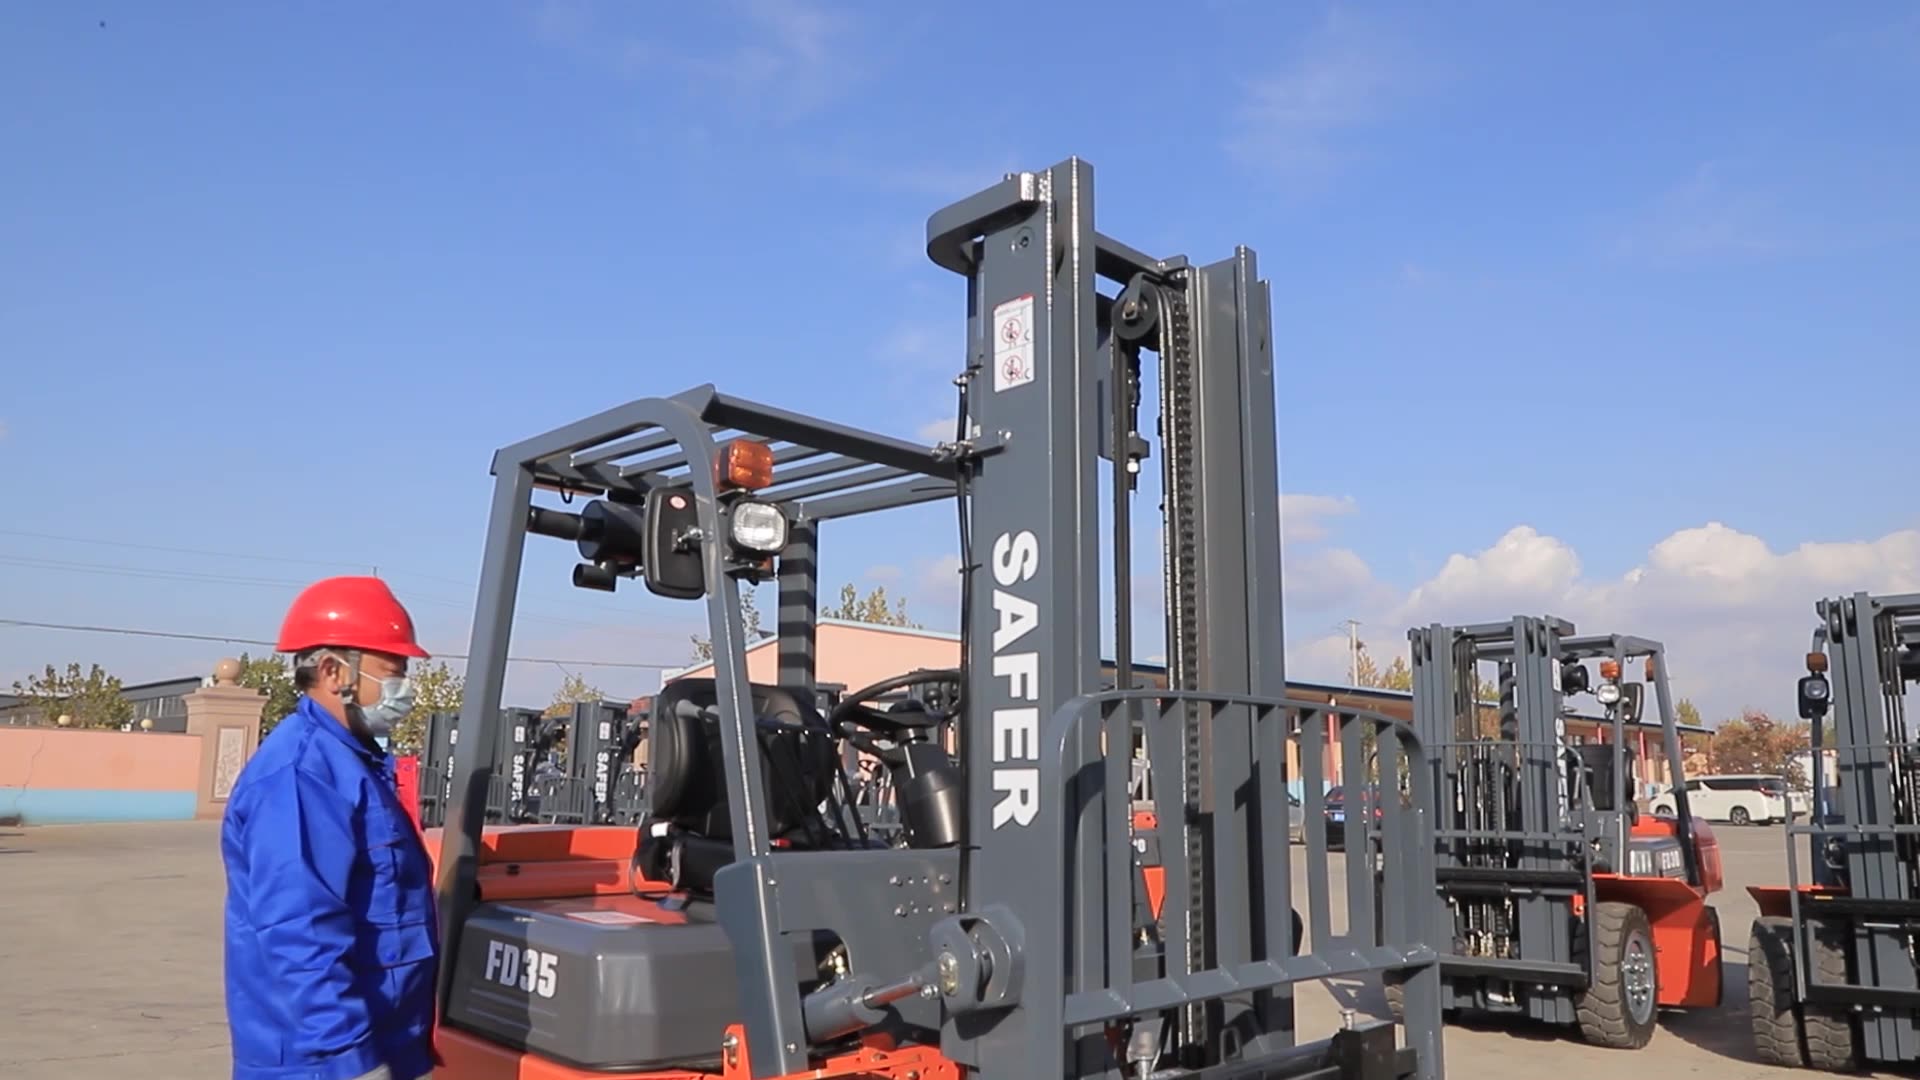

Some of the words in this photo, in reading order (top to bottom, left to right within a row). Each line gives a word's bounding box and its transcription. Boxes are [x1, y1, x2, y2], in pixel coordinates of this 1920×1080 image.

[992, 530, 1040, 830] SAFER
[511, 755, 525, 801] SAFER
[595, 752, 609, 803] SAFER
[485, 940, 558, 998] FD35
